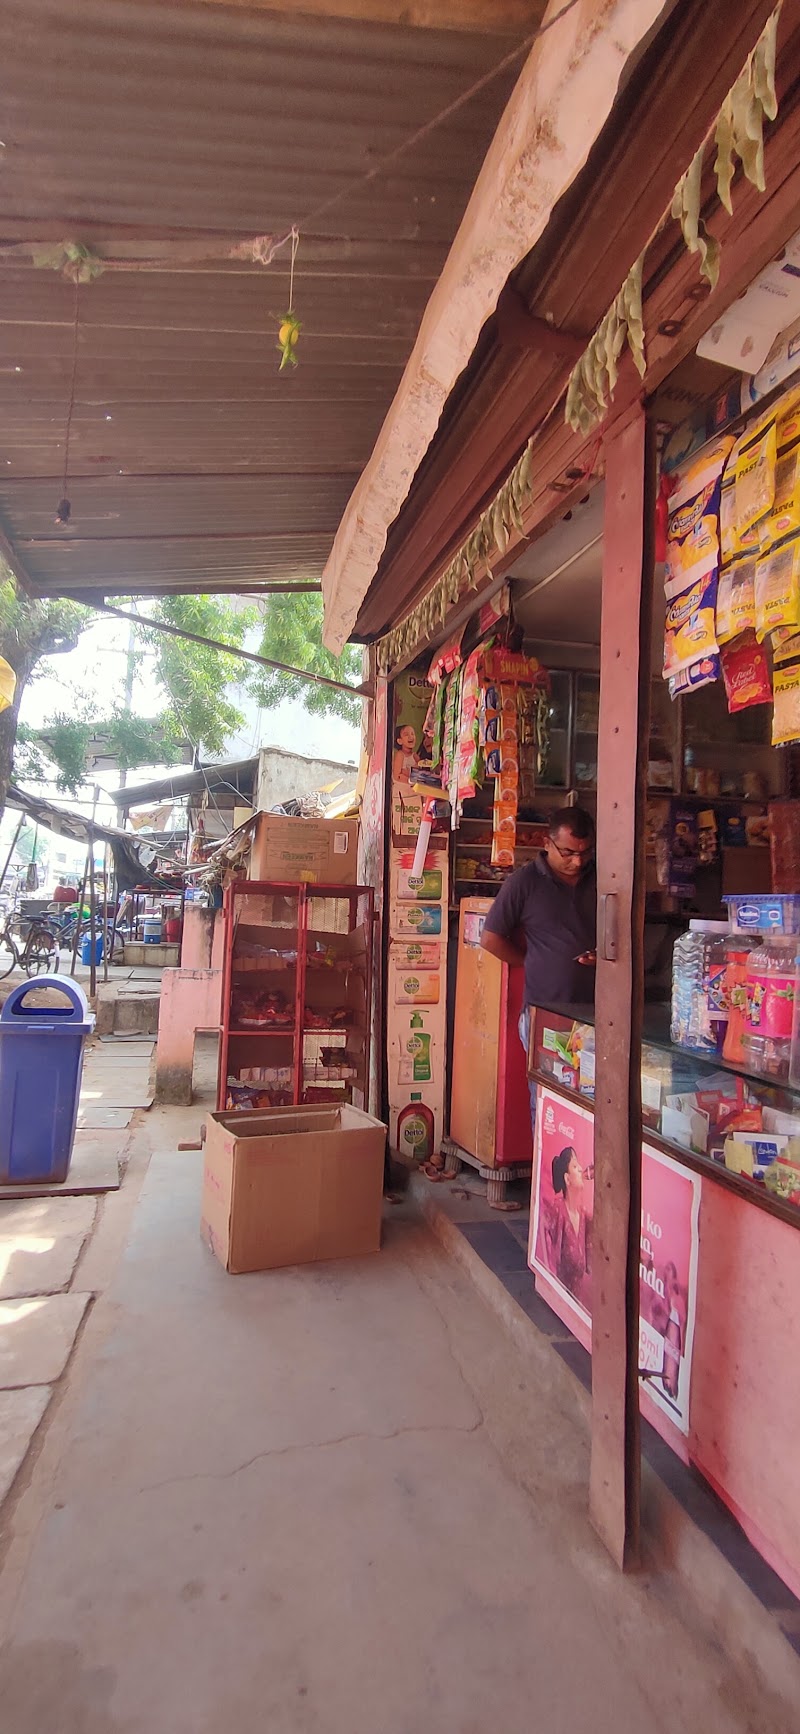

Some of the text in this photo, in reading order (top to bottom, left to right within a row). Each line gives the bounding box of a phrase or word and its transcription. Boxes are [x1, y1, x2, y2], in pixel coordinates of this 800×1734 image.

[764, 596, 791, 611] PASTA
[731, 664, 756, 681] Red
[409, 676, 434, 688] Detto
[731, 675, 756, 689] Label
[774, 679, 800, 693] PASTA
[404, 1128, 424, 1137] Dettol
[647, 1213, 662, 1239] ko
[640, 1263, 666, 1298] nda
[641, 1331, 659, 1358] 0ml
